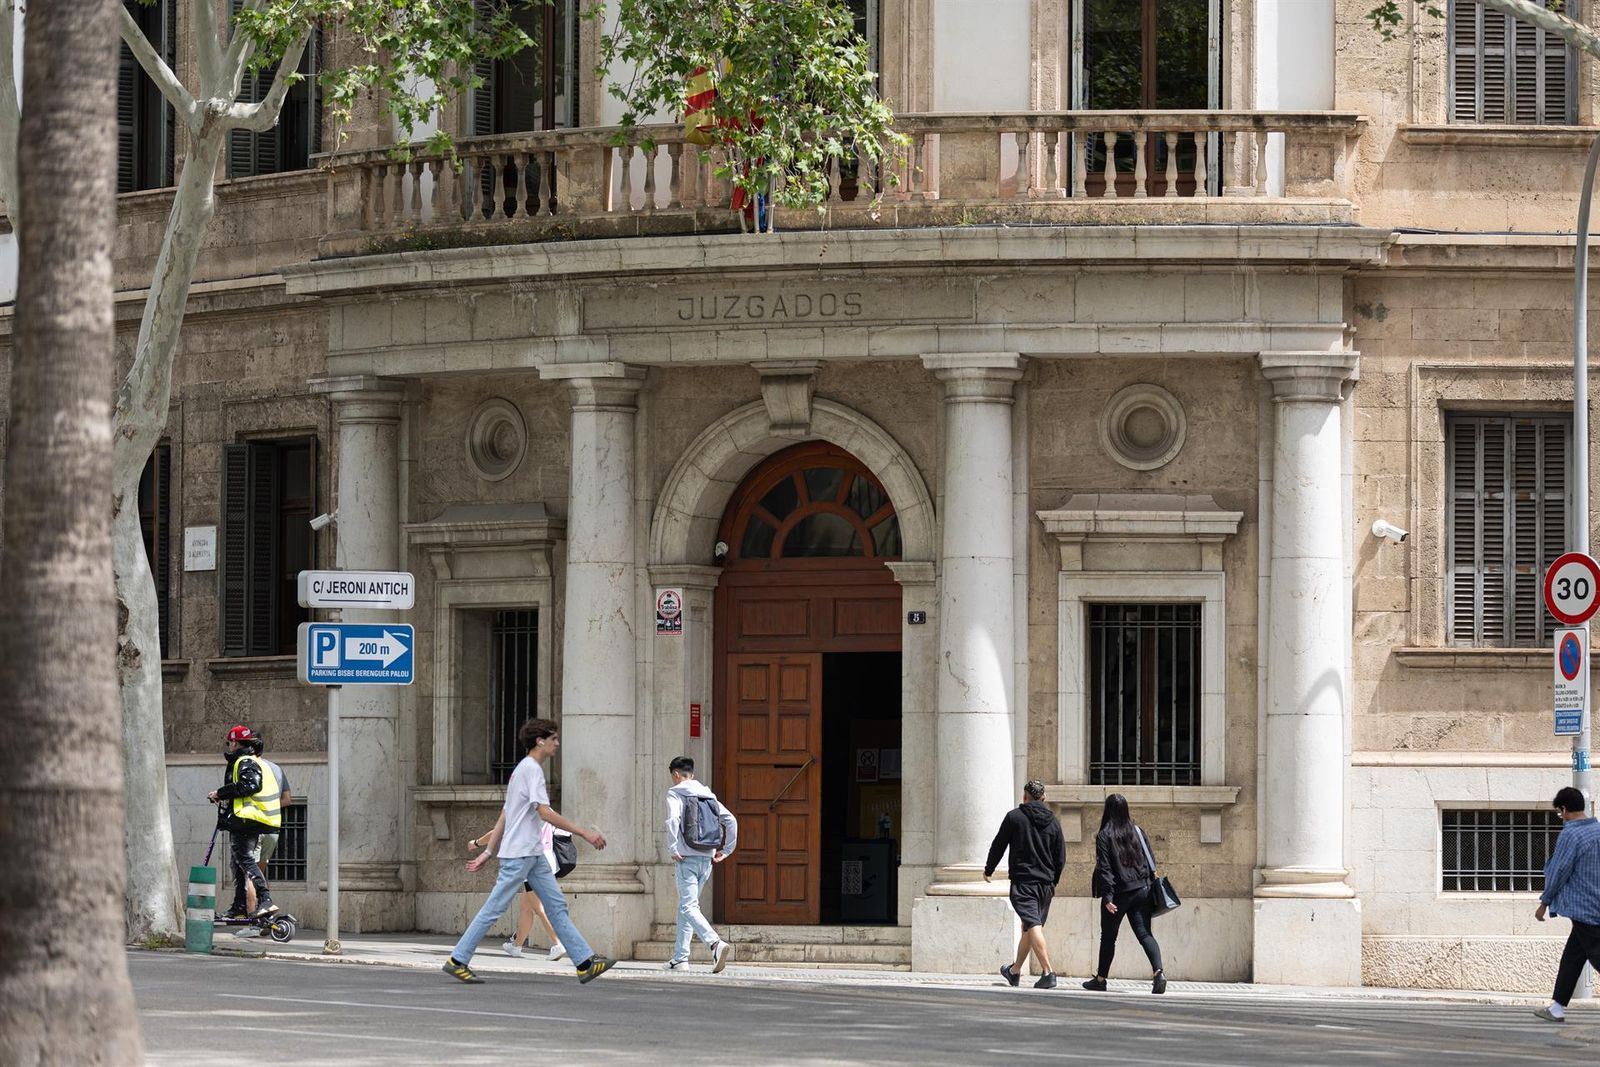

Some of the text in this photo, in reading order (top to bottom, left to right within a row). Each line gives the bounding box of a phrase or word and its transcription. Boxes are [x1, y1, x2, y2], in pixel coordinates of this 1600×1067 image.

[677, 292, 862, 321] JUZGADOS
[313, 581, 408, 595] C/ JERONI ANTICH
[1557, 577, 1589, 600] 30
[317, 632, 336, 664] P
[359, 643, 389, 654] 200 m
[355, 669, 390, 677] BERENGUER
